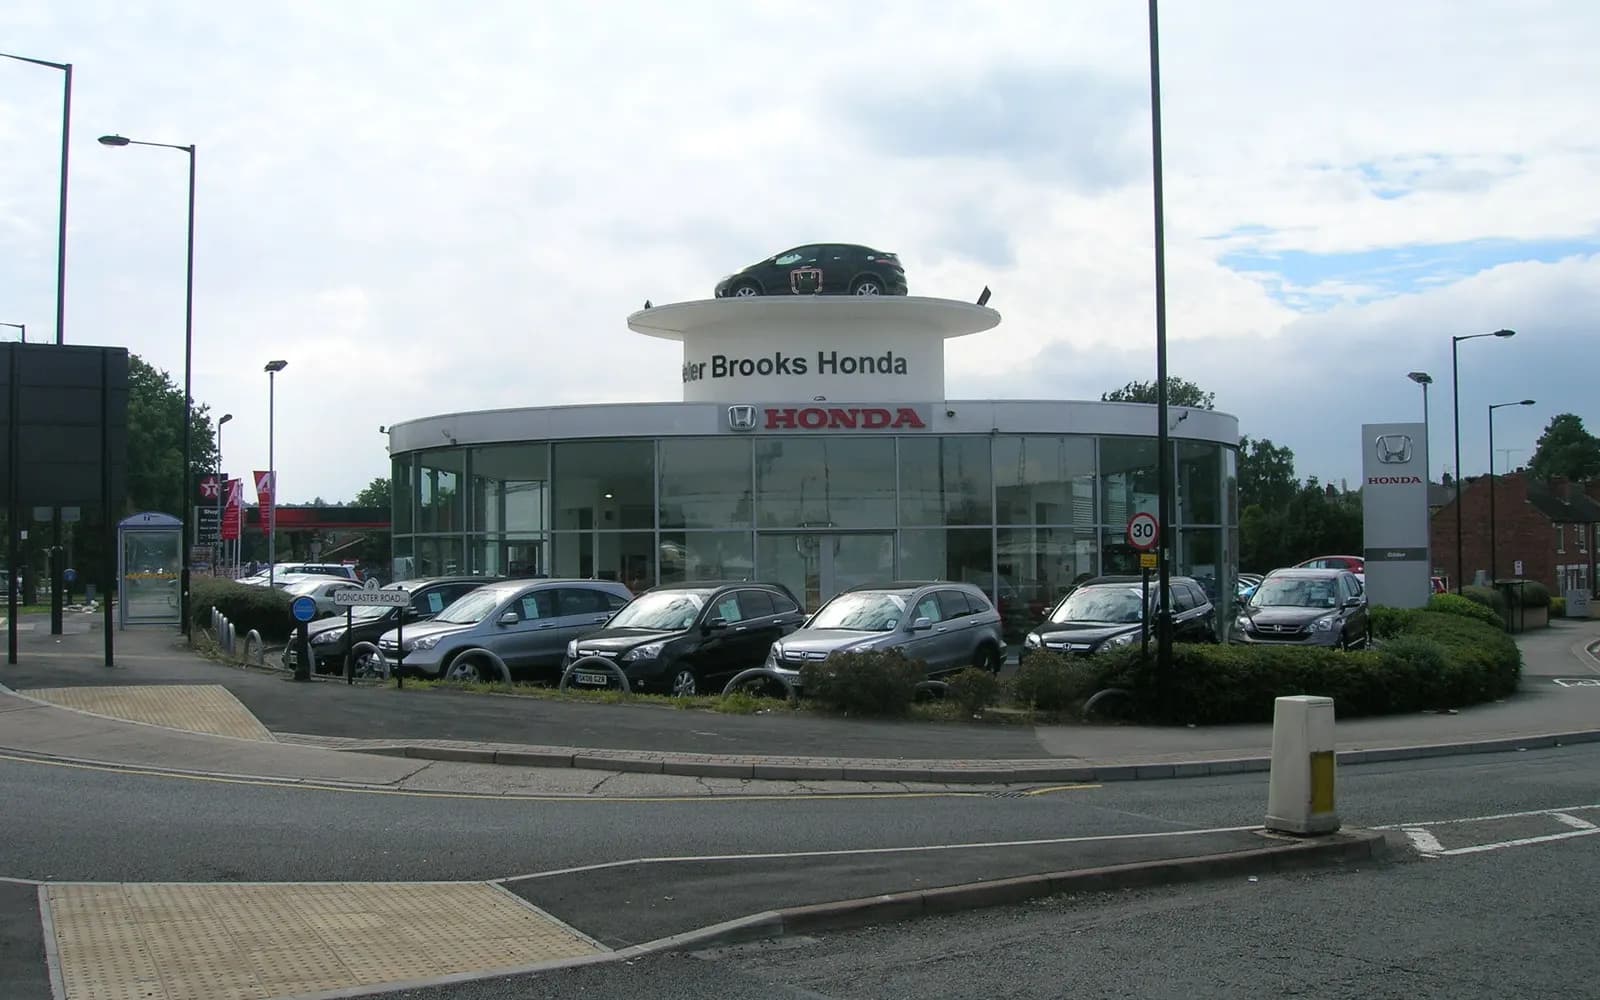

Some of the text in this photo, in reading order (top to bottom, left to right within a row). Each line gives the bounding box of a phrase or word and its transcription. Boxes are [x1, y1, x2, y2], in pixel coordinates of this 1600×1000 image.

[711, 352, 808, 378] Brooks
[818, 351, 908, 375] Honda
[764, 408, 926, 429] HONDA
[1367, 476, 1422, 485] HONDA
[1133, 523, 1154, 538] 30
[336, 593, 379, 602] DONCASTER
[380, 593, 401, 603] ROAD
